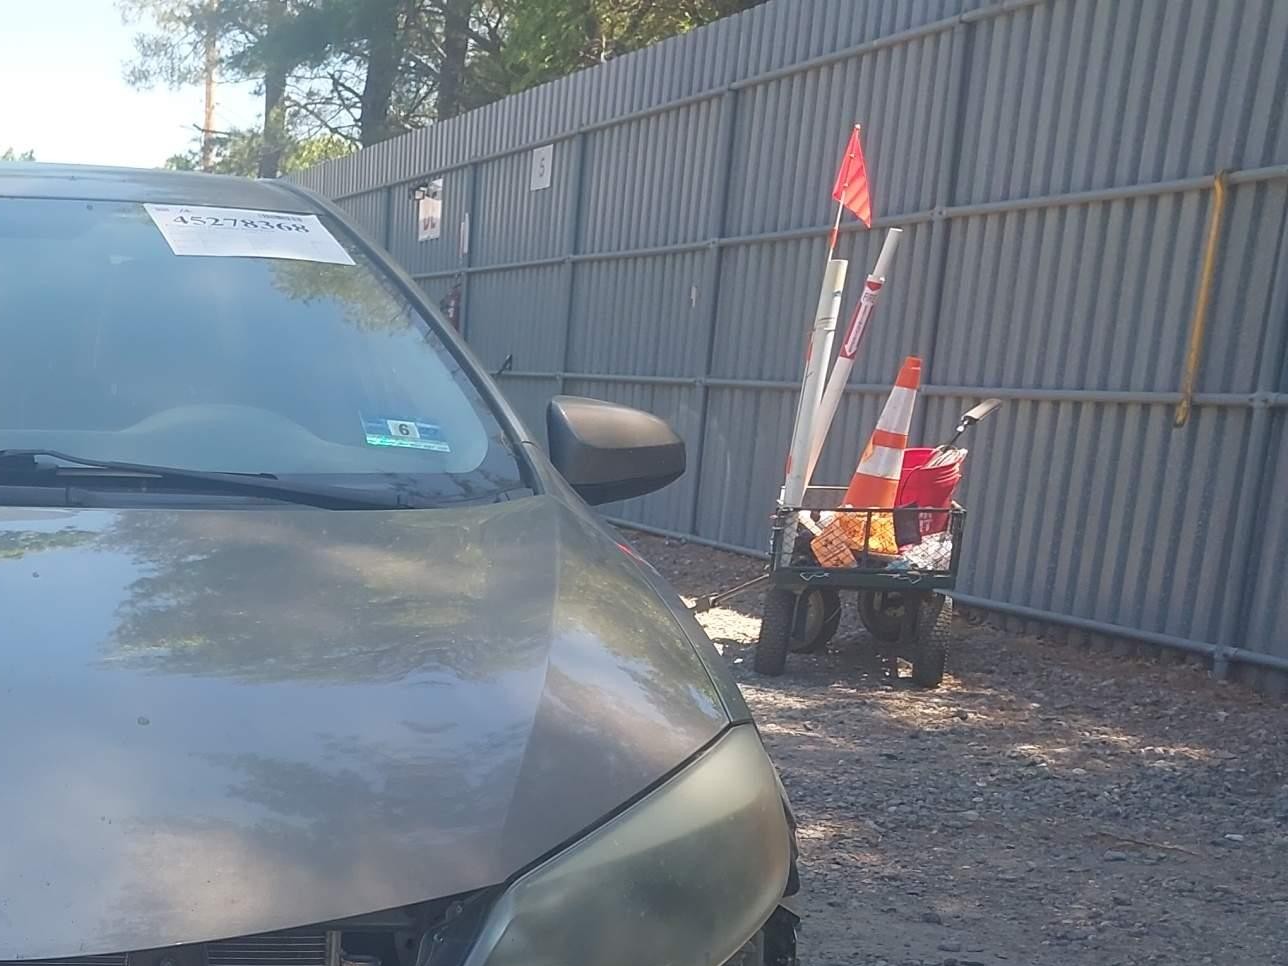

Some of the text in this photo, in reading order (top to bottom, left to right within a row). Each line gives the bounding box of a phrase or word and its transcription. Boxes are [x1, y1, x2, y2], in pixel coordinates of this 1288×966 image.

[538, 156, 546, 178] 5
[173, 215, 310, 234] 45278368
[398, 423, 410, 436] 6
